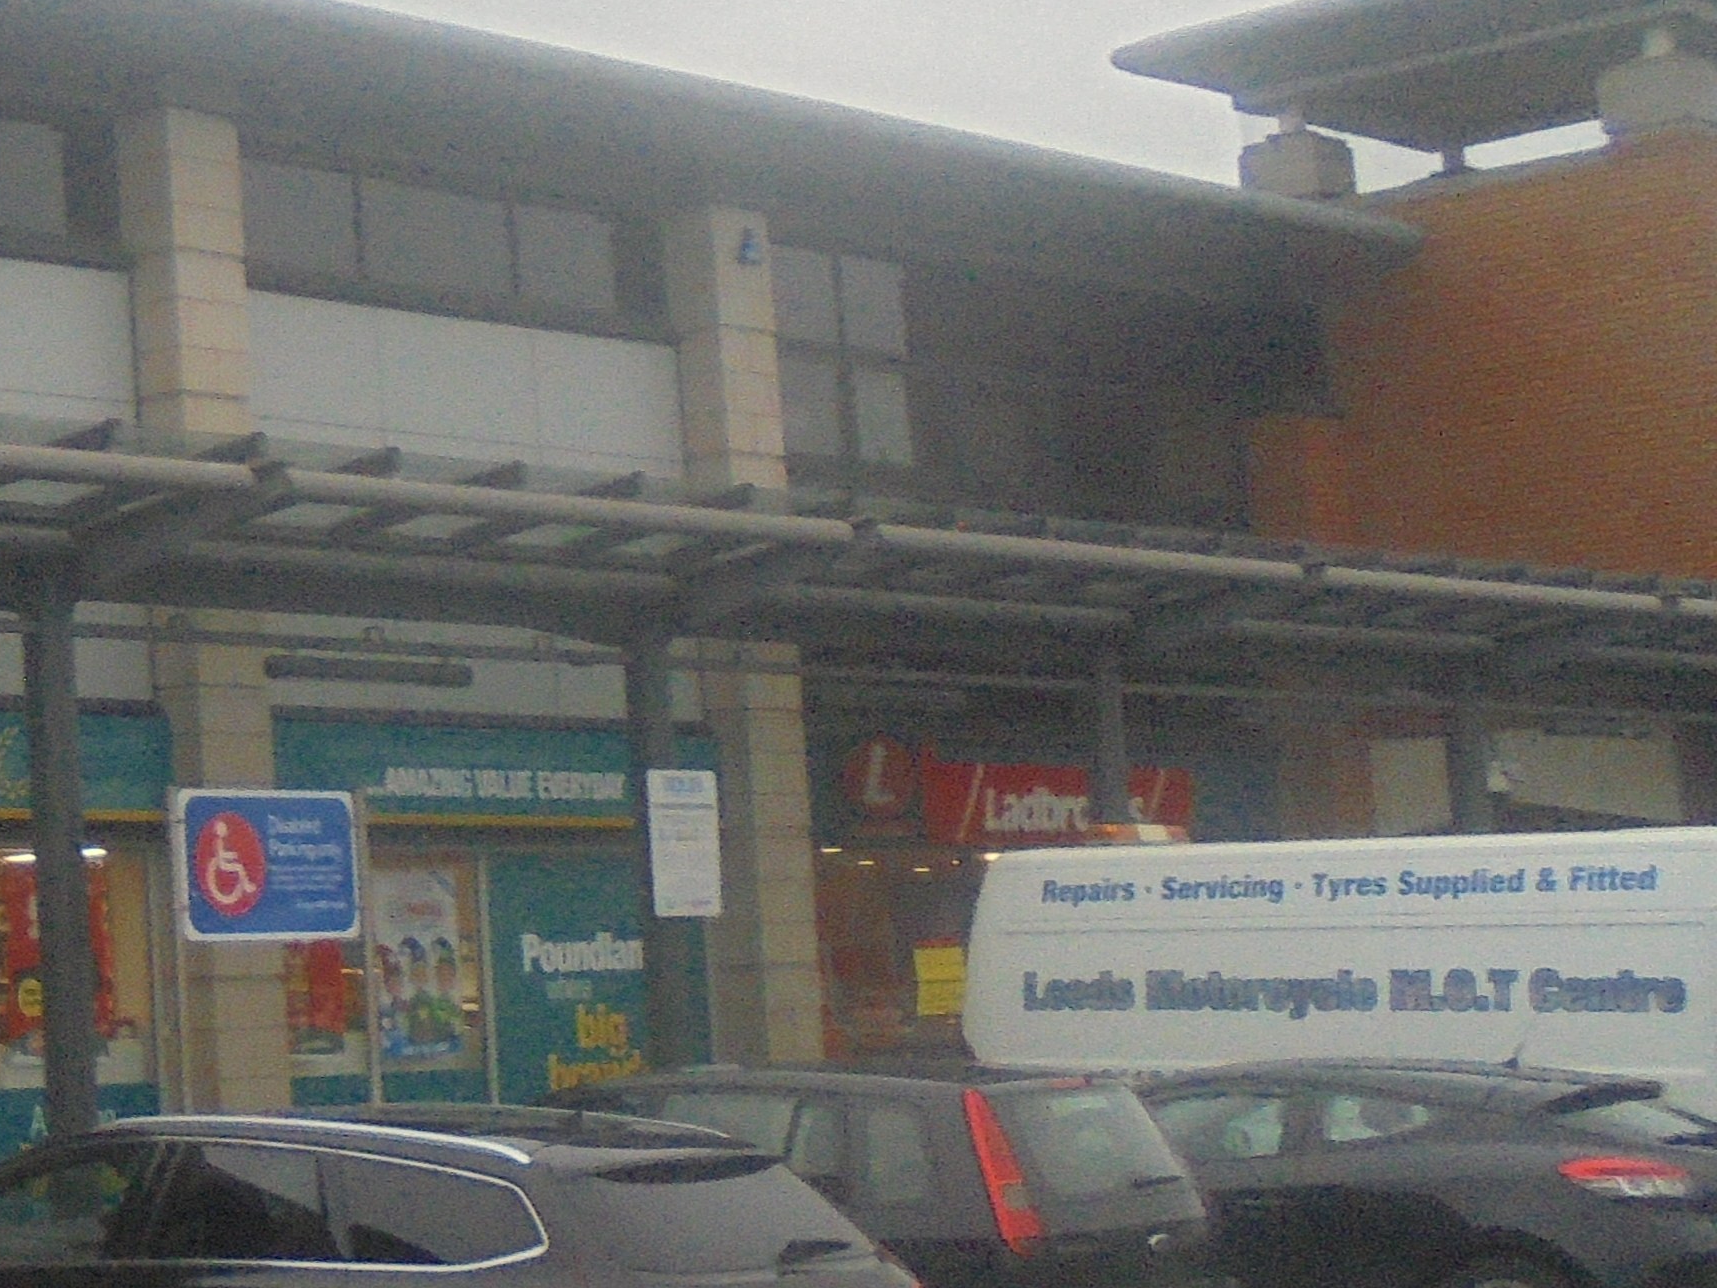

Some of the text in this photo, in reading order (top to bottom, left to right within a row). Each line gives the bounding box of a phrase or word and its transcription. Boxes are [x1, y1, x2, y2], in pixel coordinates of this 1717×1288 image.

[1041, 864, 1659, 907] Repairs Servicing Tyres Supplied & Fitted
[521, 932, 645, 973] Poundlan
[1023, 970, 1136, 1012] Leeds
